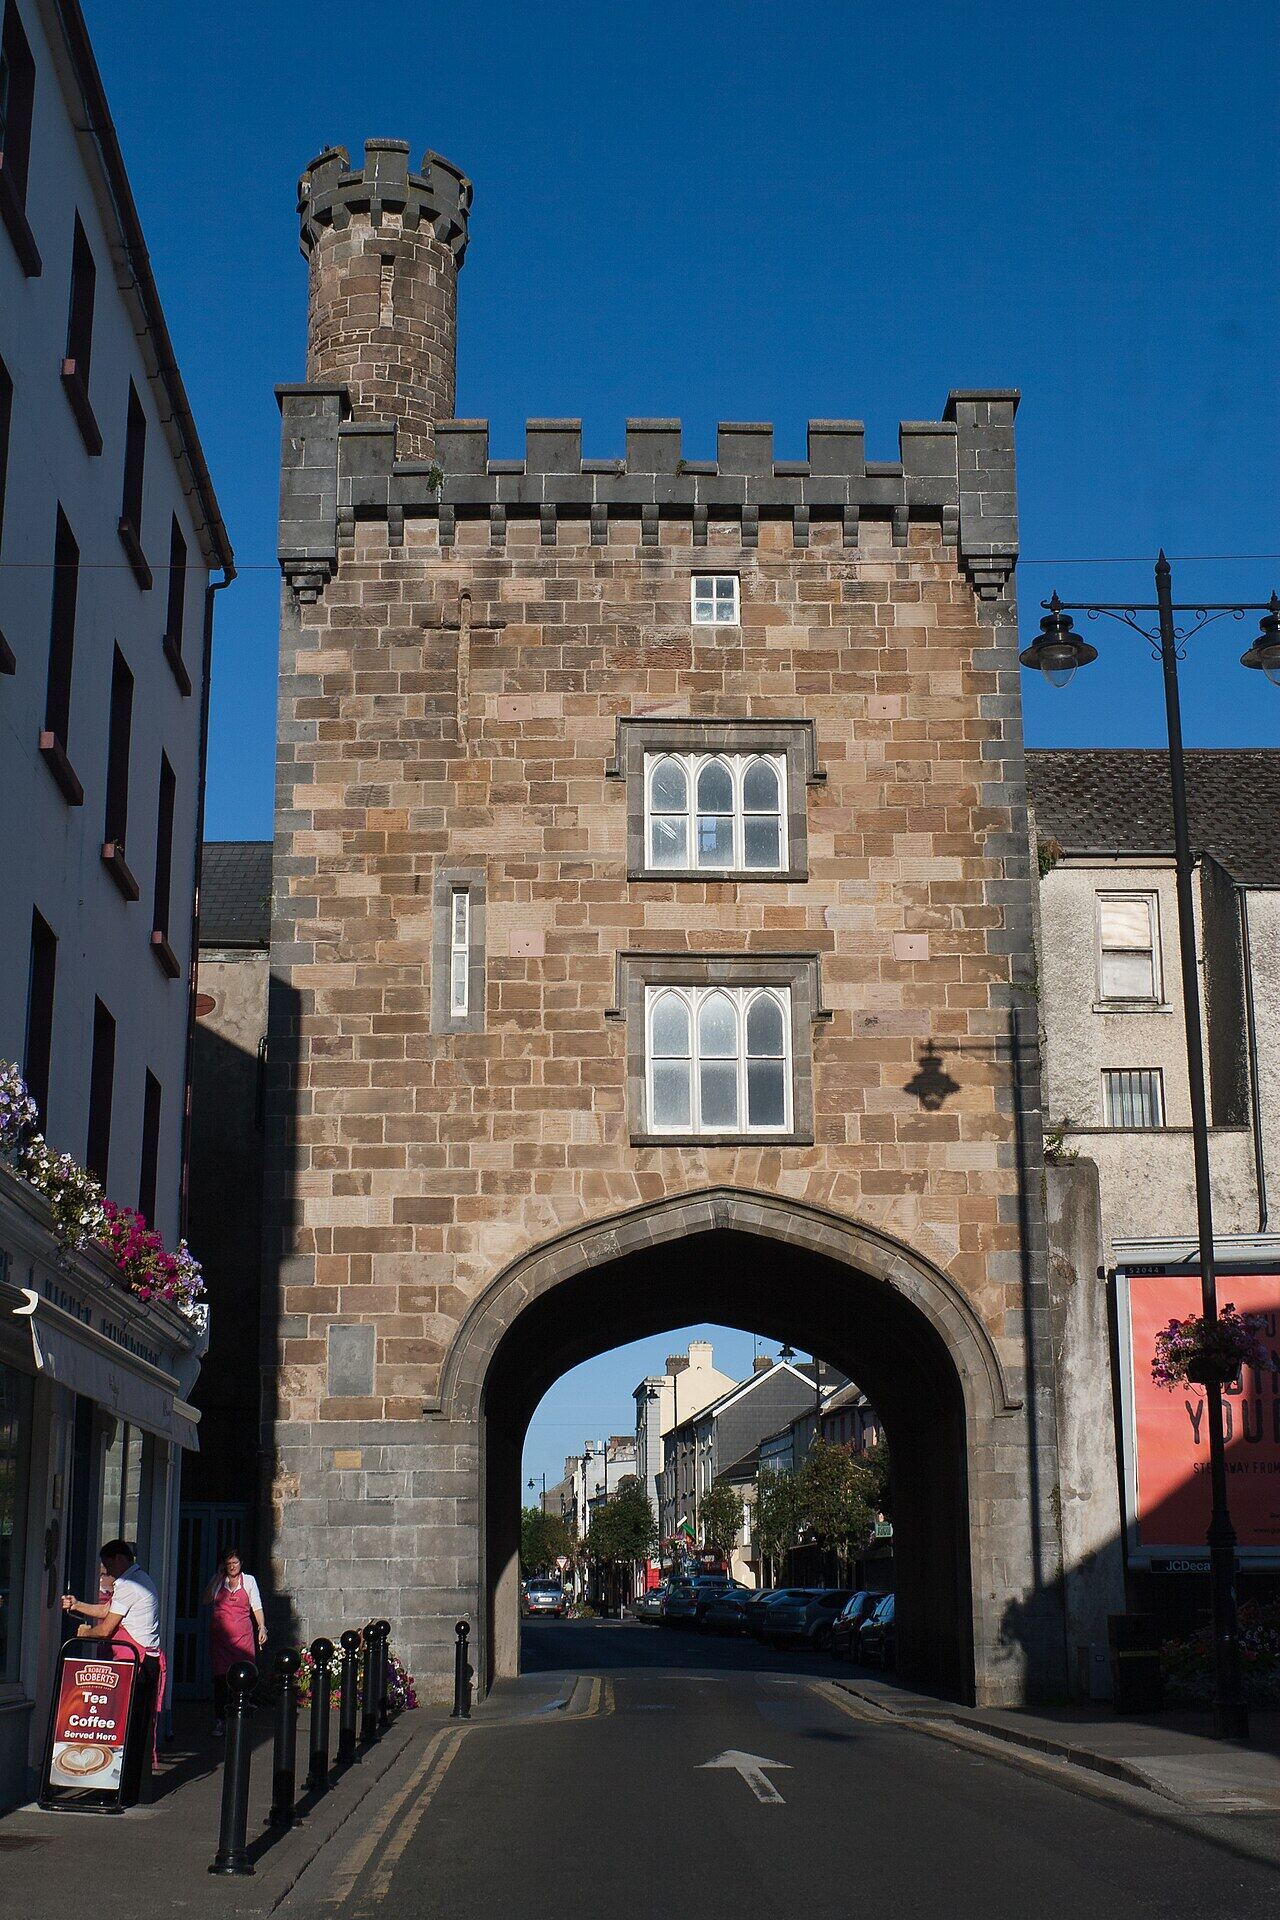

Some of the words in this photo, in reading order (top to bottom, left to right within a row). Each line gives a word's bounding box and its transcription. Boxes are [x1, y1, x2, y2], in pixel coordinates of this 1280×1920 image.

[1166, 1560, 1211, 1571] JCDeca
[80, 1673, 115, 1684] ROBERTS
[82, 1691, 108, 1704] Tea
[89, 1706, 97, 1714] &
[69, 1715, 115, 1729] Coffee
[64, 1730, 94, 1739] Served
[96, 1732, 117, 1741] Here
